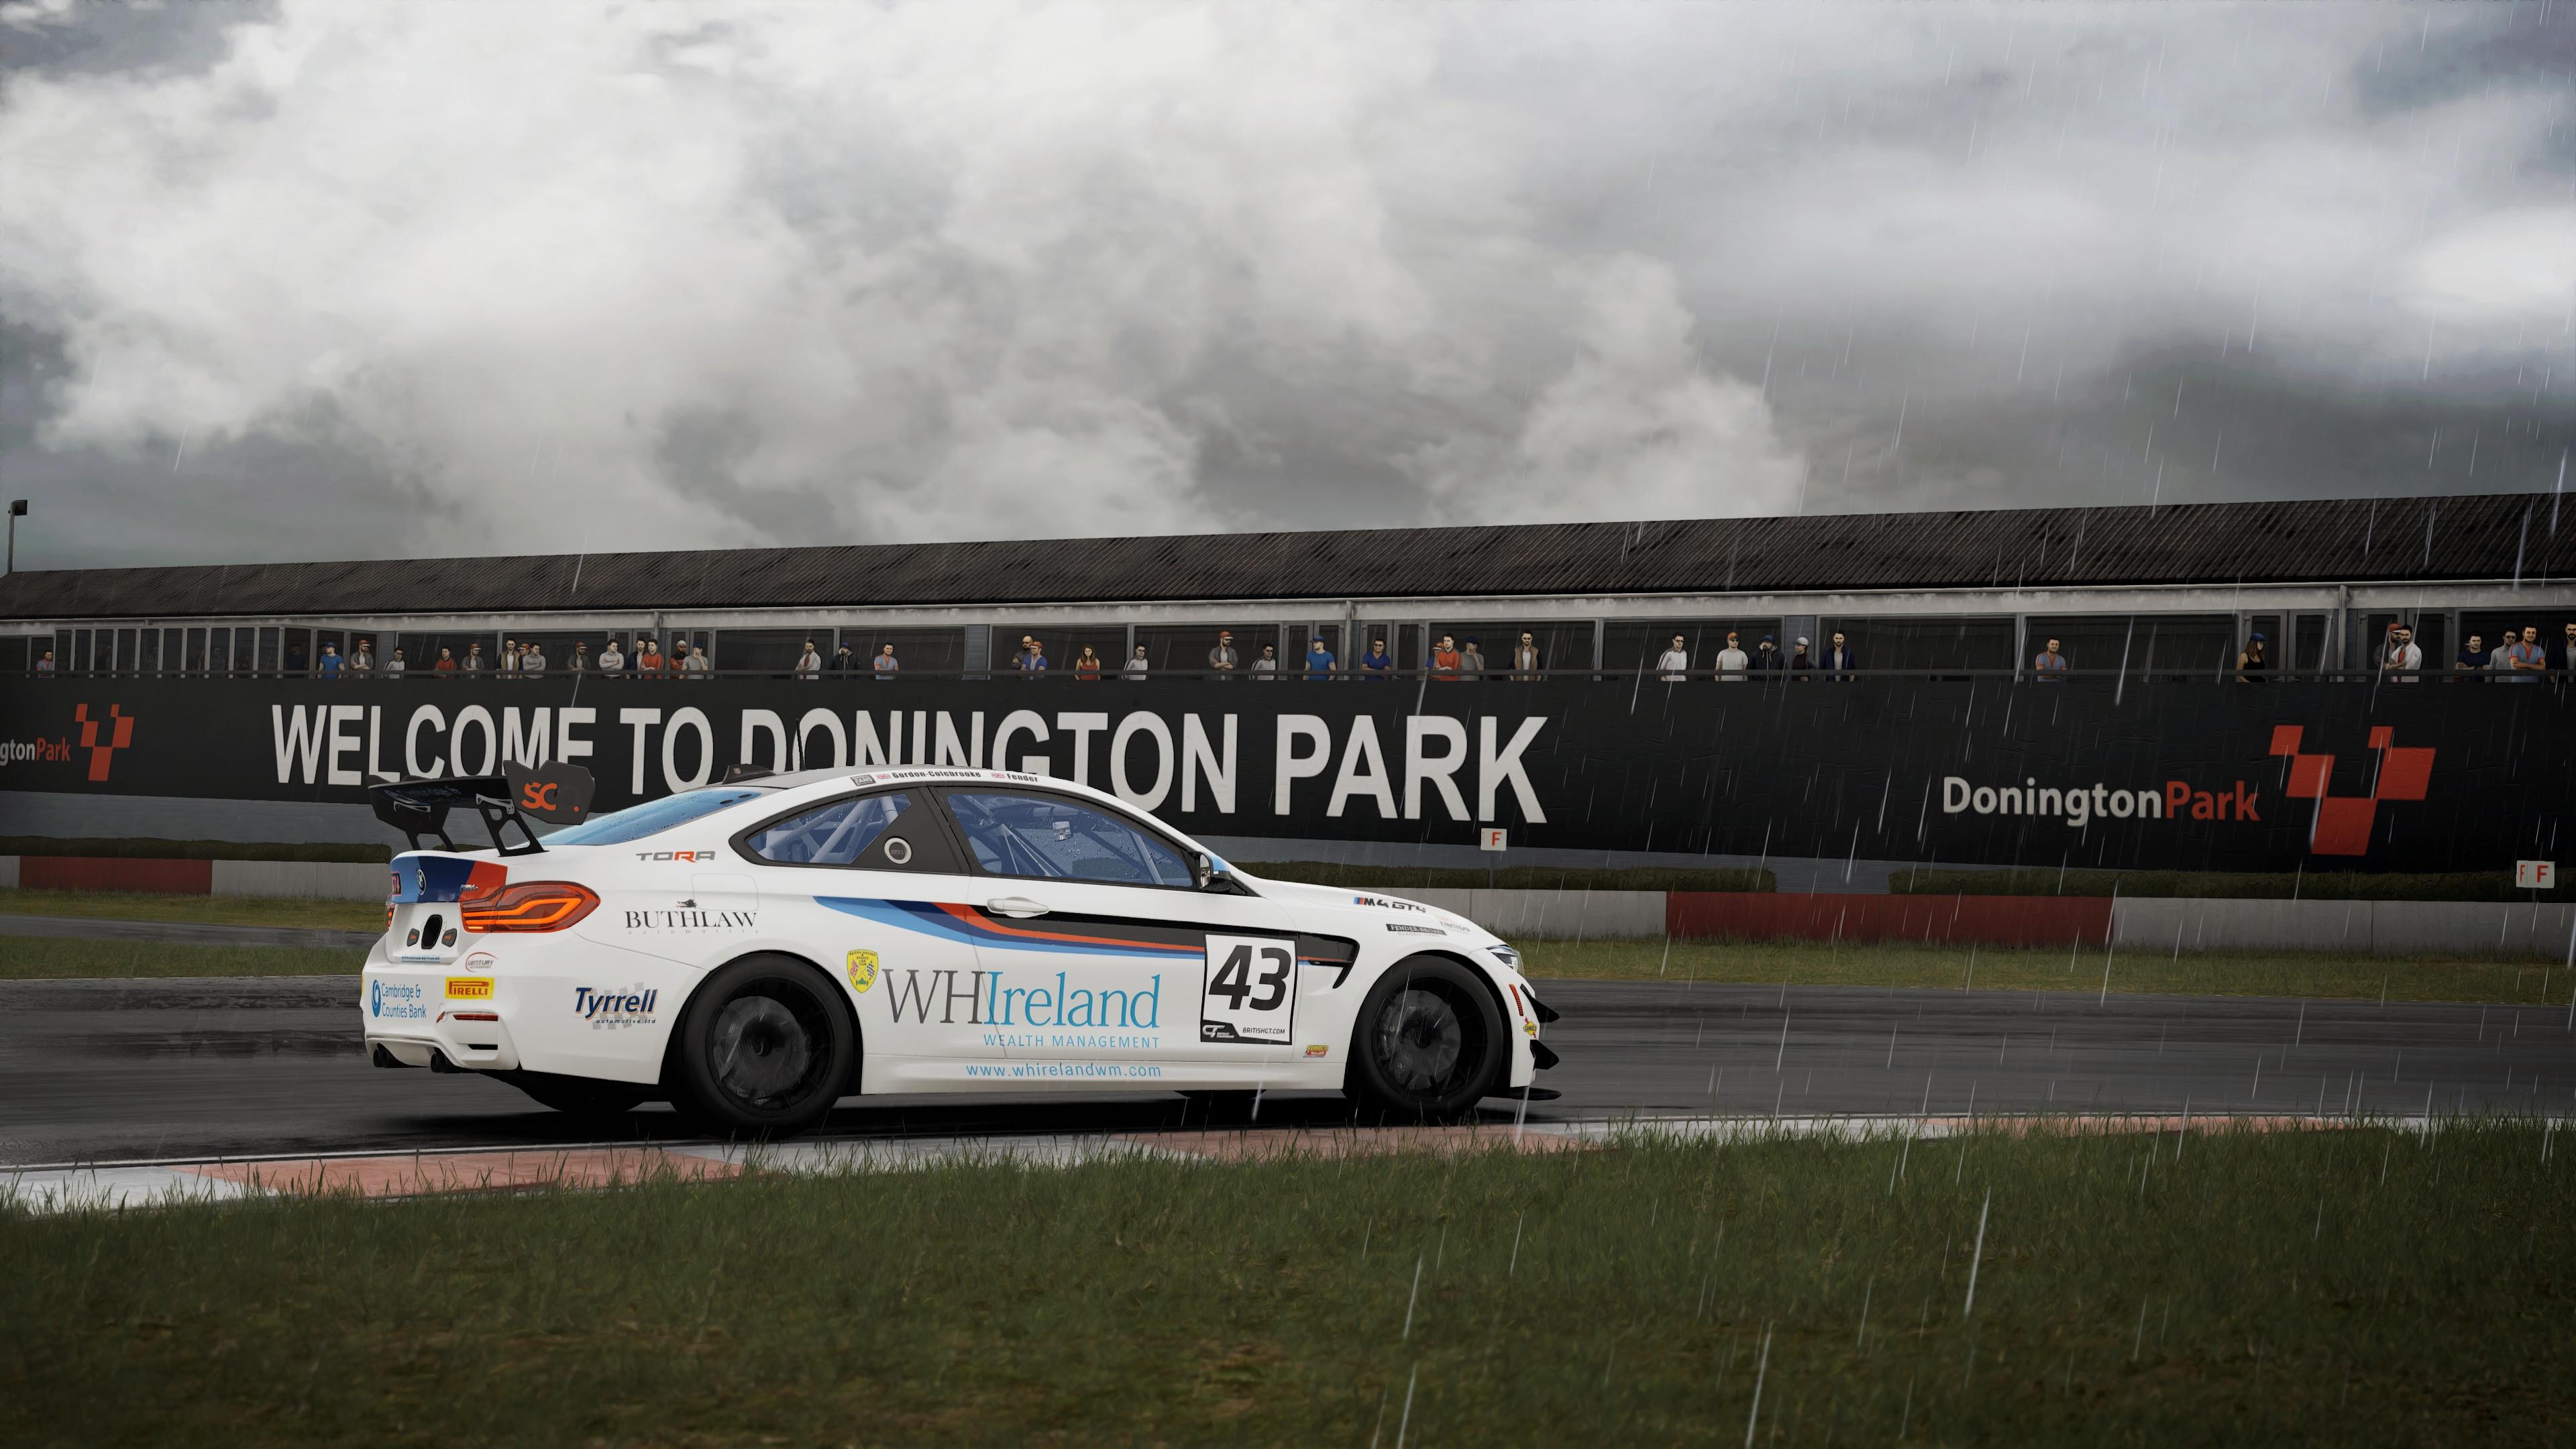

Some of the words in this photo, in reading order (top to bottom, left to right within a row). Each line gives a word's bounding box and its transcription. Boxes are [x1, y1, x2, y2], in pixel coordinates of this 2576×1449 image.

[272, 704, 596, 786] WELCOME
[620, 706, 714, 795] TO
[741, 708, 1238, 814] DONINGTON
[1275, 713, 1548, 824] PARK
[1007, 773, 1038, 782] Fender
[1943, 777, 2260, 827] DoningtonPark
[1491, 831, 1503, 847] F
[636, 851, 715, 863] TORA
[2520, 864, 2526, 883] F
[2536, 864, 2549, 883] F
[625, 911, 757, 928] BUTHLAW
[1209, 945, 1291, 1010] 43
[382, 982, 414, 999] Cambridge
[415, 985, 421, 998] &
[449, 981, 490, 996] PIRELLI
[382, 1003, 407, 1018] Counties
[409, 1006, 427, 1018] Bank
[576, 987, 658, 1020] Tyrrell
[984, 1034, 1044, 1047] WEALTH
[1053, 1036, 1160, 1049] MANAGEMENT
[967, 1062, 1161, 1077] www.whirelandwm.com
